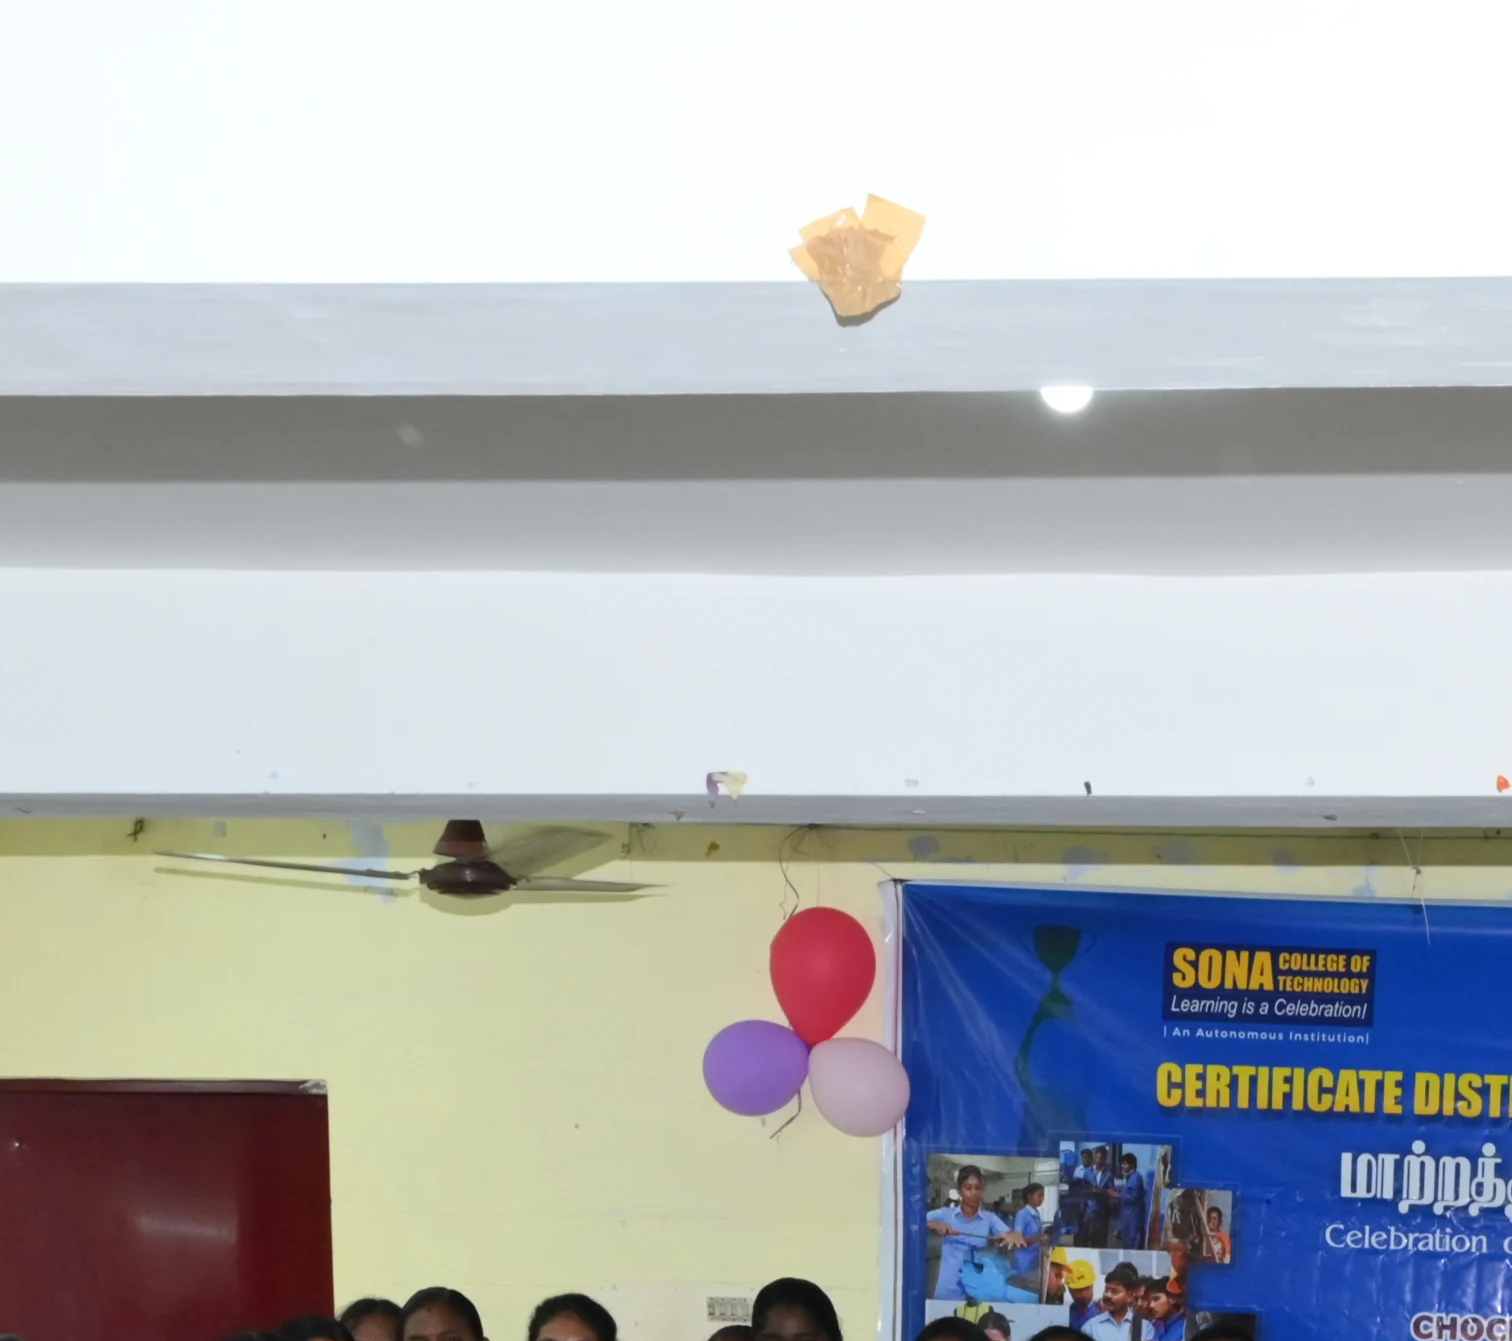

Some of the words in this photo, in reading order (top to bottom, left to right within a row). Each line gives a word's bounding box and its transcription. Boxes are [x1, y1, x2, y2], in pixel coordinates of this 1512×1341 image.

[1172, 947, 1274, 991] SONA
[1278, 952, 1347, 973] COLLEGE
[1350, 955, 1371, 973] OF
[1277, 975, 1369, 994] TECHNOLOGY
[1171, 995, 1238, 1018] Learning
[1242, 998, 1255, 1015] is
[1259, 1003, 1269, 1015] a
[1274, 998, 1368, 1020] Celebration!
[1172, 1027, 1190, 1037] An
[1195, 1027, 1284, 1041] Autonomous
[1155, 1061, 1404, 1116] CERTIFICATE
[1324, 1223, 1487, 1253] Celebration
